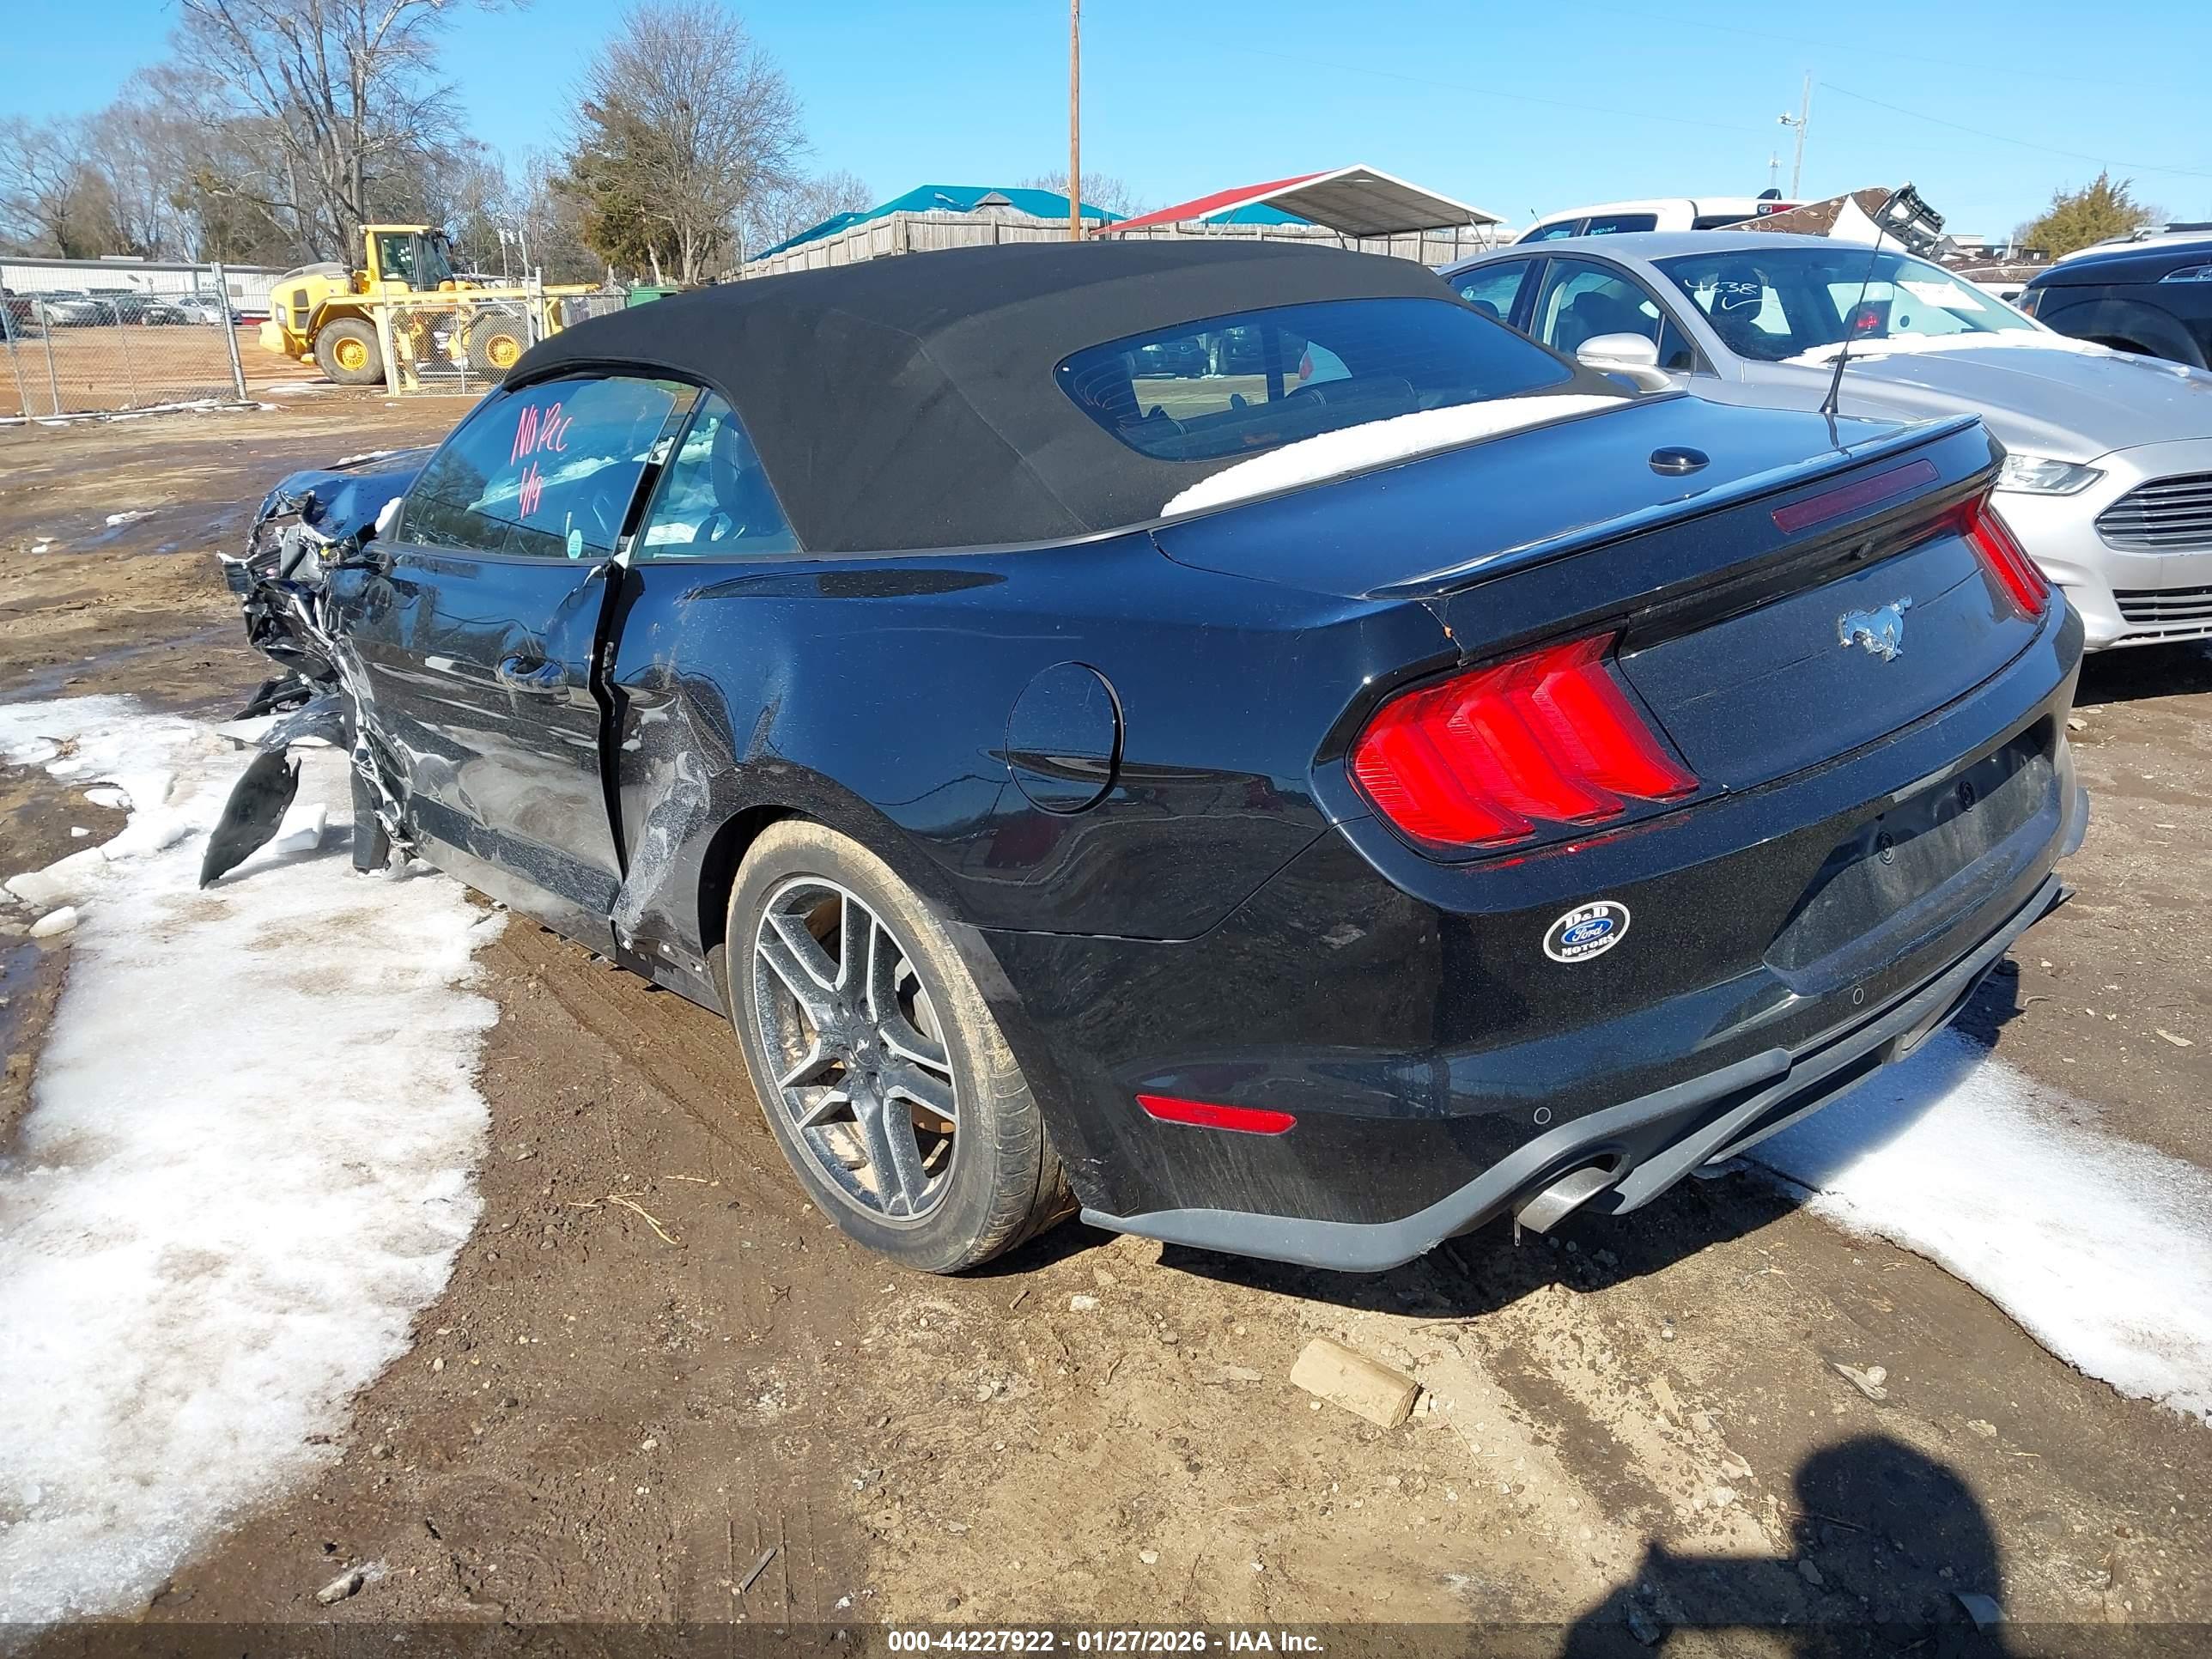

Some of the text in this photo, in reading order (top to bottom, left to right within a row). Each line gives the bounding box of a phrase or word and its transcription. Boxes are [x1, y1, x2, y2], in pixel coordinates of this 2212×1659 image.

[1684, 279, 1759, 295] 4638
[511, 404, 538, 466] NO
[1565, 907, 1609, 929] D&D
[1572, 923, 1603, 942] Ford
[1562, 933, 1615, 958] MOTORS
